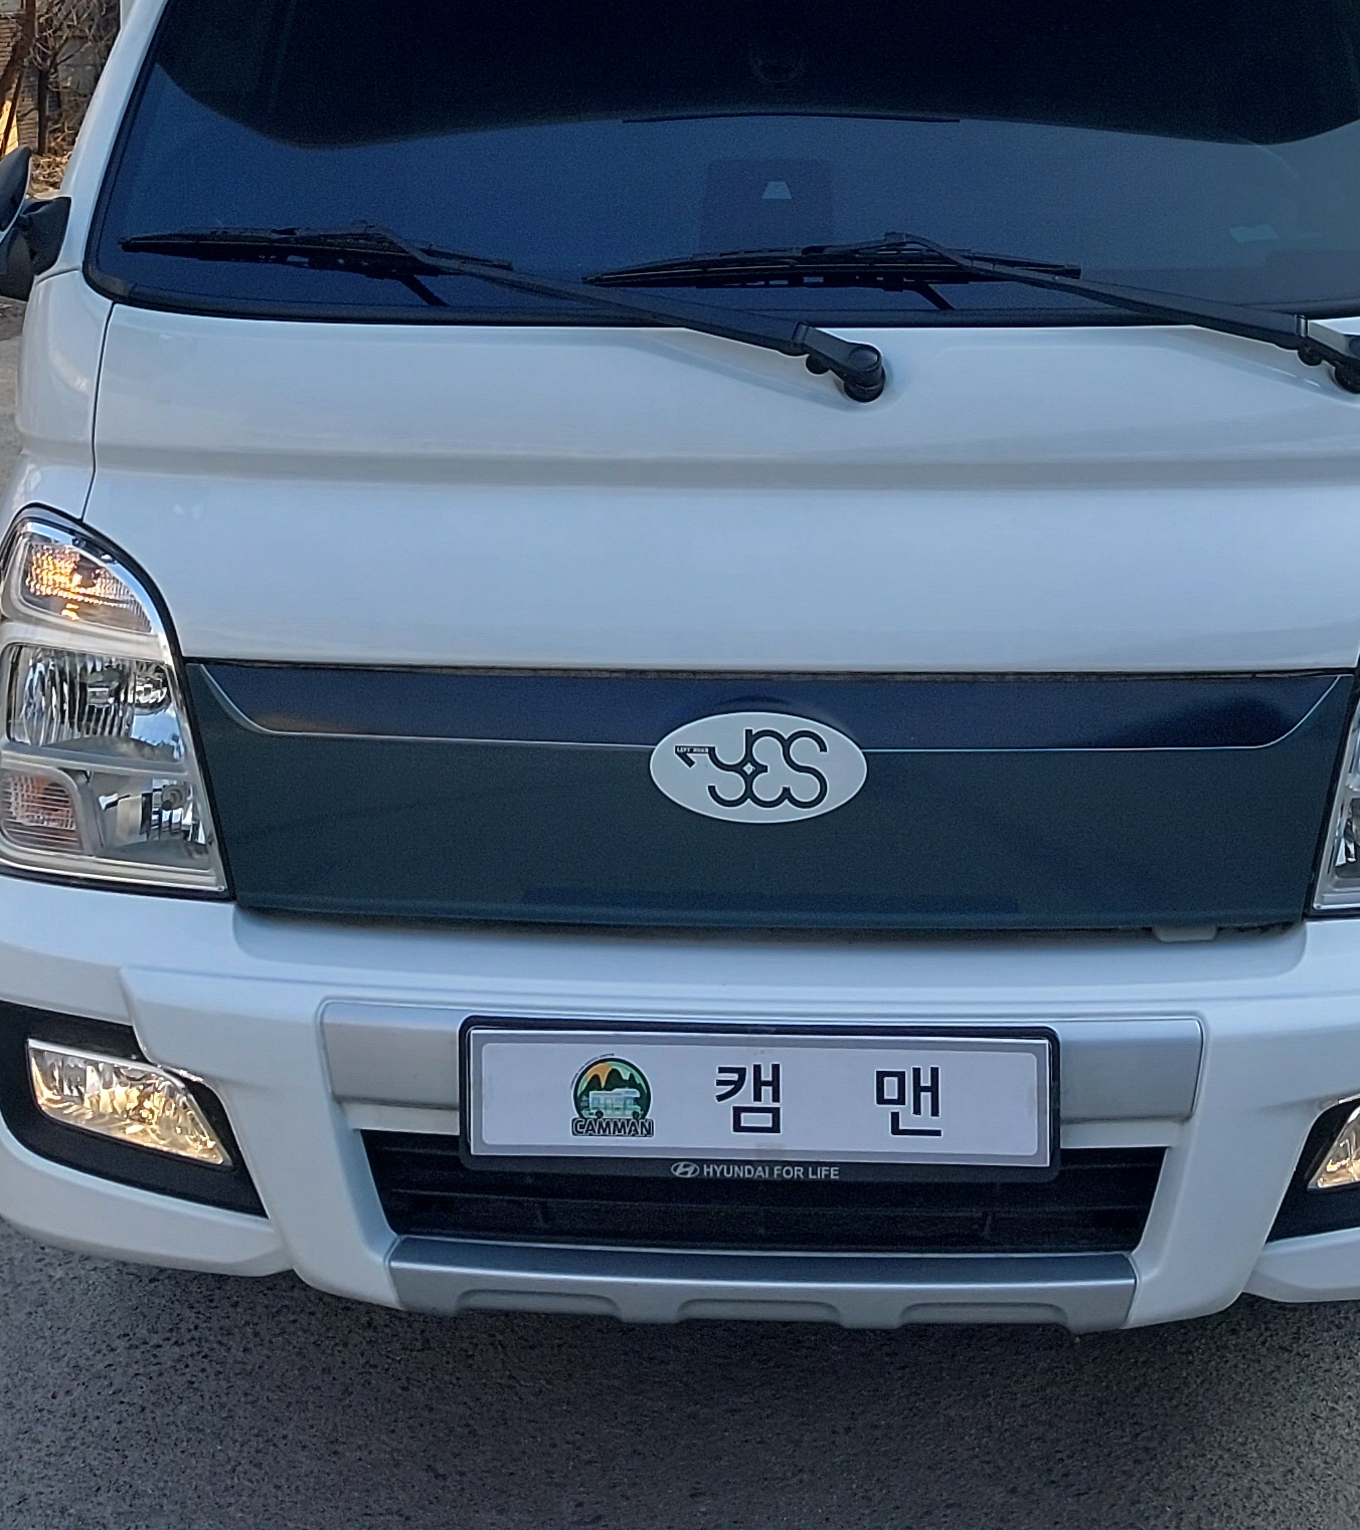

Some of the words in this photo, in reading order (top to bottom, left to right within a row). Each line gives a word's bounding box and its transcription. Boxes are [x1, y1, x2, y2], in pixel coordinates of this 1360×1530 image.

[574, 1118, 653, 1137] CAMMAN
[703, 1164, 769, 1178] HYUNDAI
[774, 1165, 804, 1179] FOR
[808, 1166, 840, 1179] LIFE
